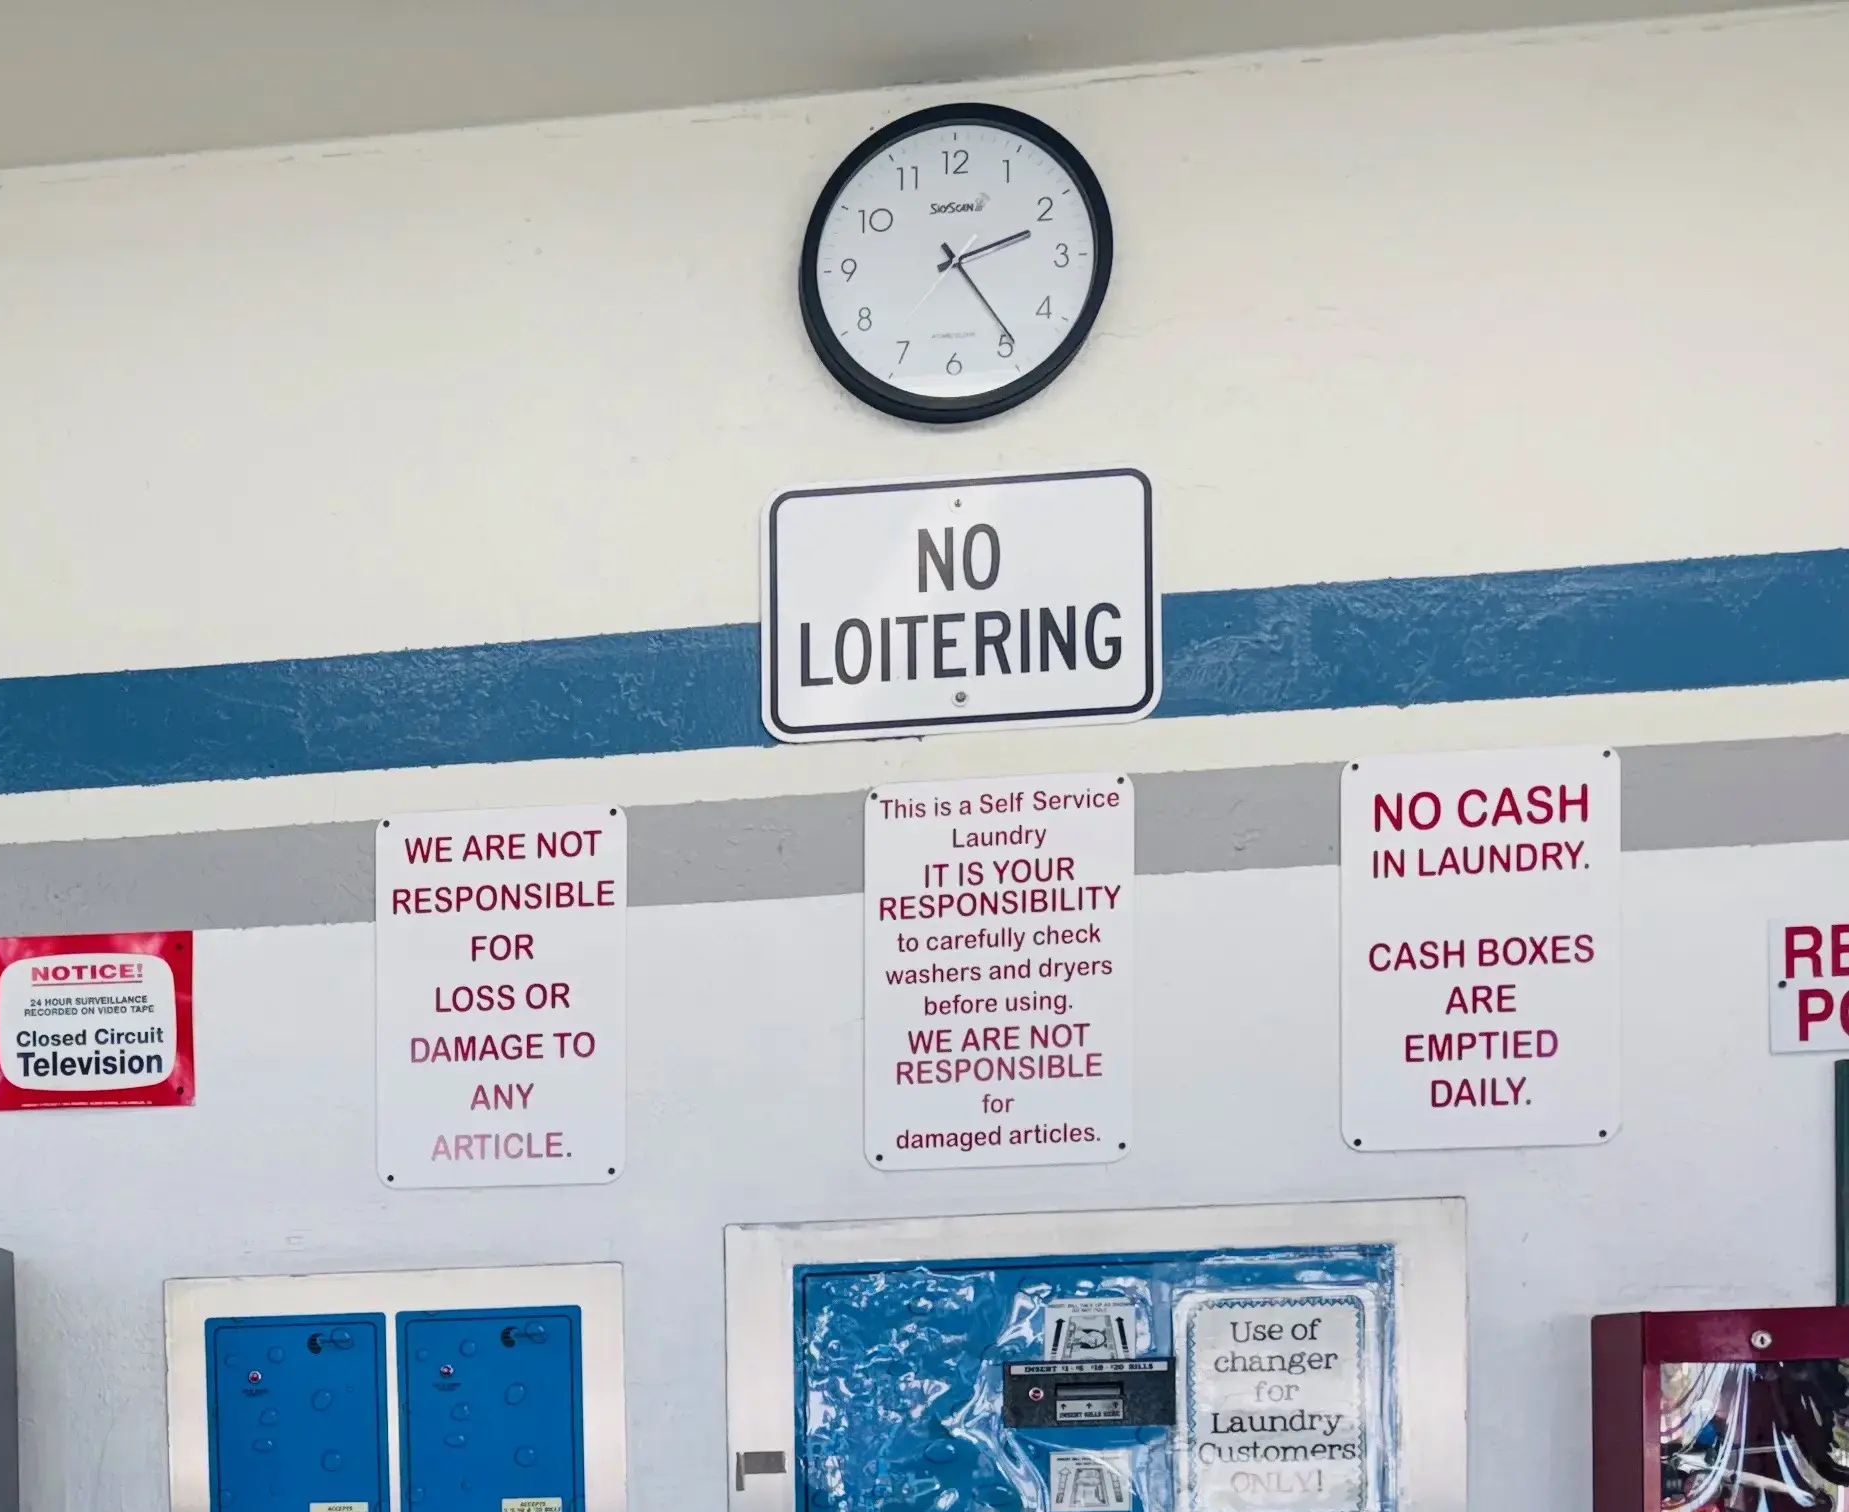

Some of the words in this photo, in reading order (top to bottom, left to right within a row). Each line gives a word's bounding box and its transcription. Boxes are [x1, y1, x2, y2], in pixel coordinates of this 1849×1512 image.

[942, 150, 969, 175] 12
[1002, 159, 1011, 183] 1
[897, 166, 919, 191] 11
[858, 208, 893, 233] 10
[1037, 197, 1054, 221] 2
[1053, 243, 1069, 268] 3
[841, 258, 857, 282] 9
[857, 307, 872, 331] 8
[1036, 295, 1051, 318] 4
[897, 341, 910, 364] 7
[997, 334, 1014, 358] 5
[946, 353, 962, 375] 6
[918, 523, 1000, 593] NO
[800, 602, 1121, 687] LOITERING
[880, 797, 926, 820] This
[933, 795, 952, 817] is
[959, 799, 972, 815] a
[979, 792, 1025, 814] Self
[1033, 788, 1121, 812] Service
[1373, 791, 1441, 832] NO
[1457, 783, 1589, 828] CASH
[405, 836, 452, 864] WE
[463, 833, 526, 862] ARE
[537, 830, 602, 859] NOT
[952, 825, 1047, 850] Laundry
[924, 863, 949, 888] IT
[958, 861, 984, 886] IS
[993, 857, 1075, 885] YOUR
[1372, 848, 1405, 879] IN
[1418, 840, 1590, 878] LAUNDRY.
[392, 879, 615, 915] RESPONSIBLE
[879, 884, 1121, 921] RESPONSIBILITY
[472, 933, 534, 962] FOR
[897, 933, 919, 953] to
[926, 927, 1026, 952] carefully
[1032, 923, 1101, 946] check
[1368, 938, 1465, 972] CASH
[1477, 933, 1595, 967] BOXES
[31, 963, 143, 981] NOTICE!
[885, 962, 981, 985] washers
[989, 958, 1031, 980] and
[1038, 956, 1113, 981] dryers
[24, 1006, 78, 1017] RECORDED
[81, 1006, 94, 1015] ON
[98, 1005, 127, 1015] VIDEO
[131, 1004, 154, 1013] TAPE
[30, 998, 42, 1007] 24
[45, 997, 72, 1006] HOUR
[75, 995, 147, 1005] SURVEILLANCE
[435, 985, 516, 1013] LOSS
[525, 982, 570, 1010] OR
[924, 994, 998, 1016] before
[1005, 991, 1073, 1015] using.
[1445, 983, 1517, 1015] ARE
[1798, 988, 1849, 1042] P
[16, 1029, 87, 1047] Closed
[94, 1027, 164, 1045] Circuit
[410, 1033, 544, 1064] DAMAGE
[553, 1031, 595, 1059] TO
[907, 1029, 952, 1055] WE
[961, 1026, 1020, 1053] ARE
[1030, 1023, 1090, 1050] NOT
[1404, 1029, 1559, 1063] EMPTIED
[17, 1050, 163, 1077] Television
[896, 1053, 1103, 1086] RESPONSIBLE
[470, 1082, 535, 1111] ANY
[982, 1093, 1015, 1114] for
[1430, 1076, 1531, 1108] DAILY.
[431, 1131, 572, 1162] ARTICLE.
[896, 1126, 1002, 1152] damaged
[1009, 1123, 1101, 1146] articles.
[1230, 1321, 1284, 1343] Use
[1291, 1318, 1322, 1341] of
[1214, 1351, 1338, 1375] changer
[1254, 1380, 1300, 1402] for
[1211, 1409, 1343, 1436] Laundry
[1198, 1441, 1356, 1466] Customers
[1230, 1469, 1323, 1494] ONLY!
